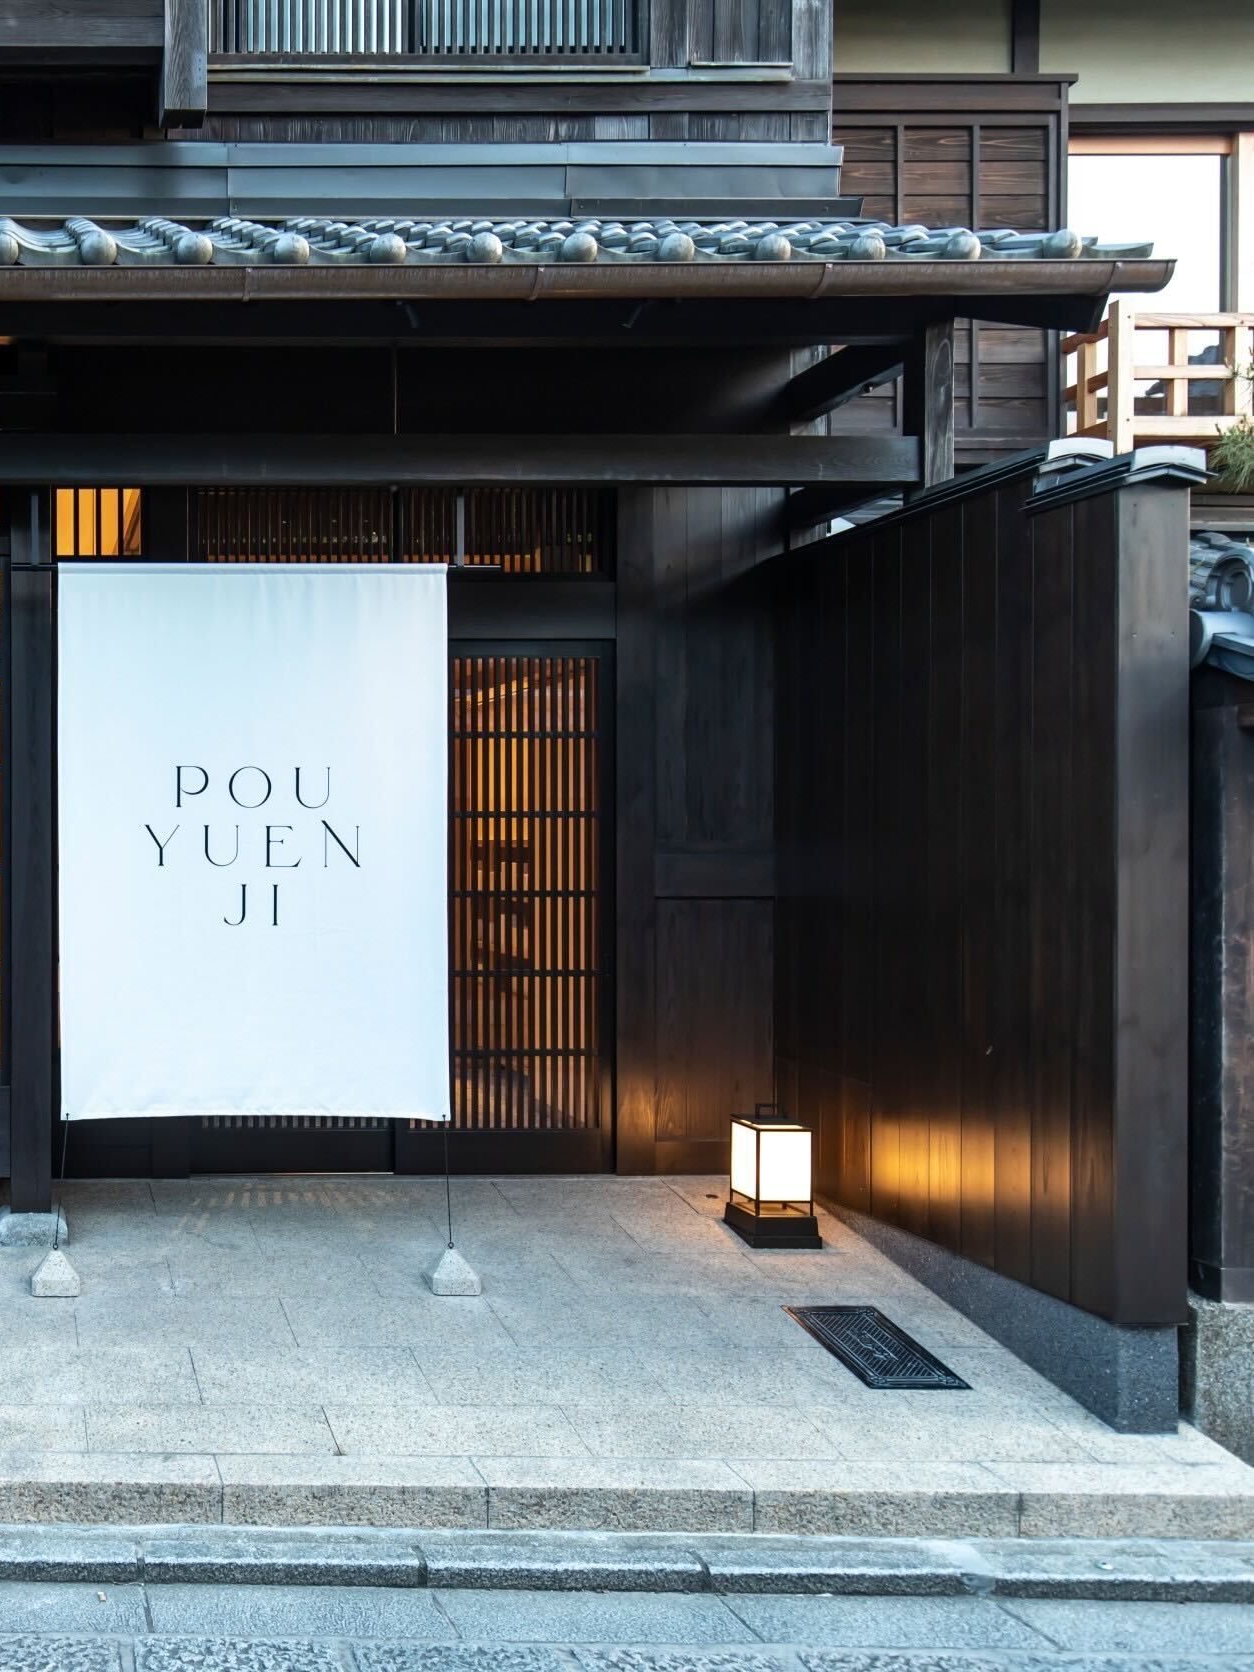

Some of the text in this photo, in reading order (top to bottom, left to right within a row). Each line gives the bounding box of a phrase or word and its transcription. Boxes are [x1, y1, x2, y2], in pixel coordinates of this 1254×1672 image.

[175, 765, 331, 809] POU
[144, 819, 361, 868] YUEN
[223, 883, 279, 927] JI
